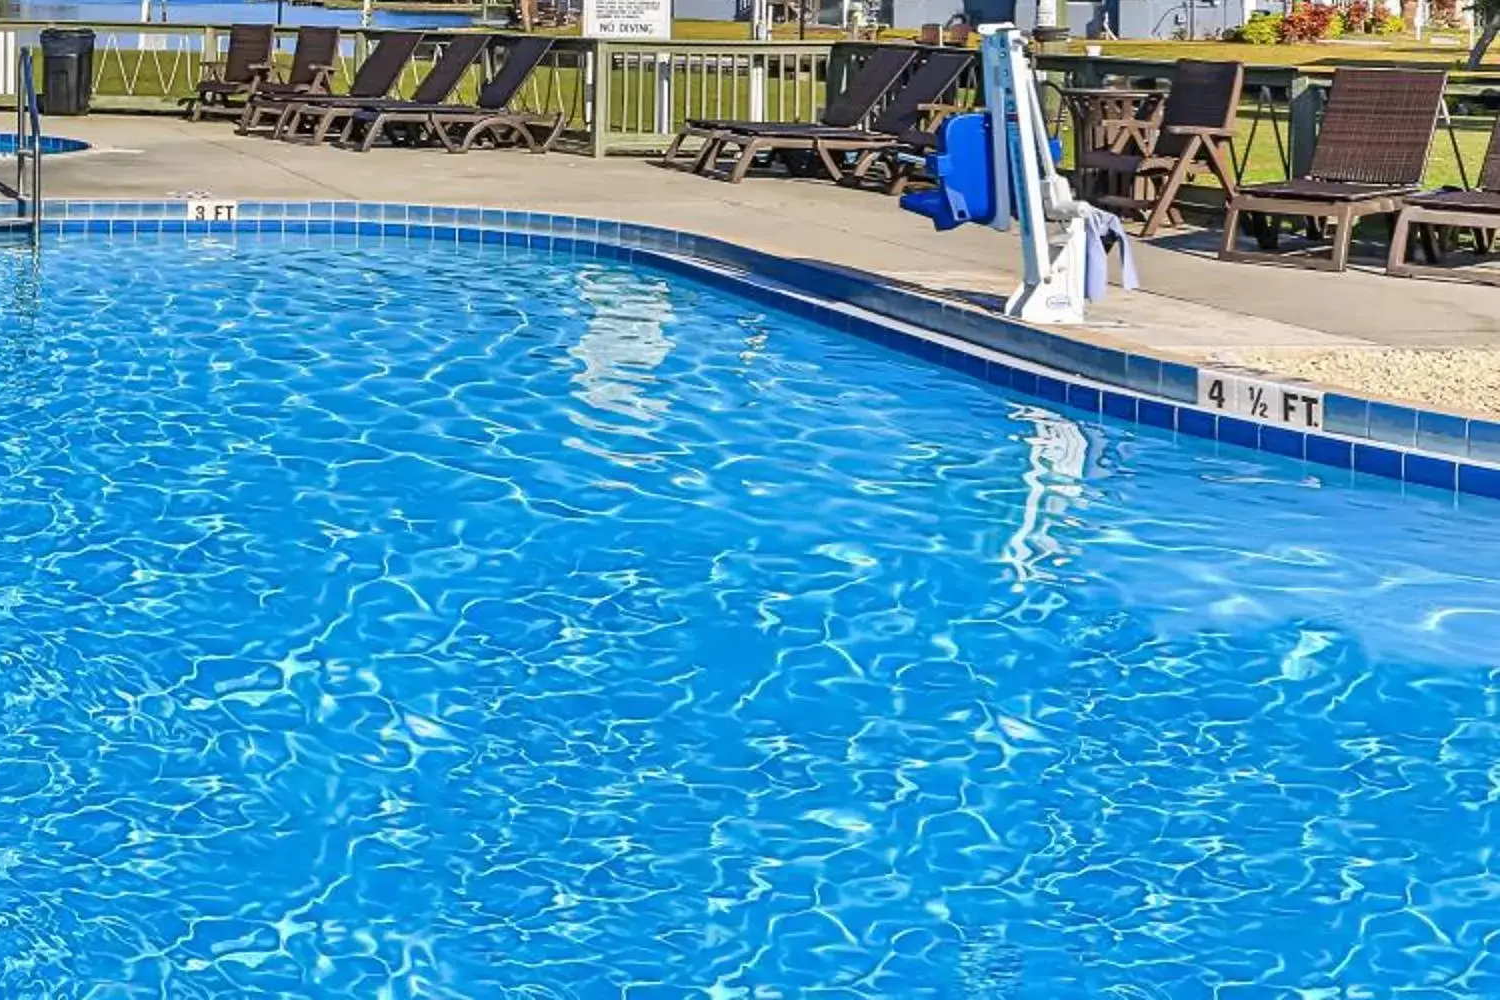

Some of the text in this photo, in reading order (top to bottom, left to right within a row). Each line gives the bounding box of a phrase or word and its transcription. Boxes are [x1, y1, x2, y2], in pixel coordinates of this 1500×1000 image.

[599, 23, 653, 34] NO DIVING
[195, 205, 235, 221] 3 FT
[1208, 379, 1225, 408] 4
